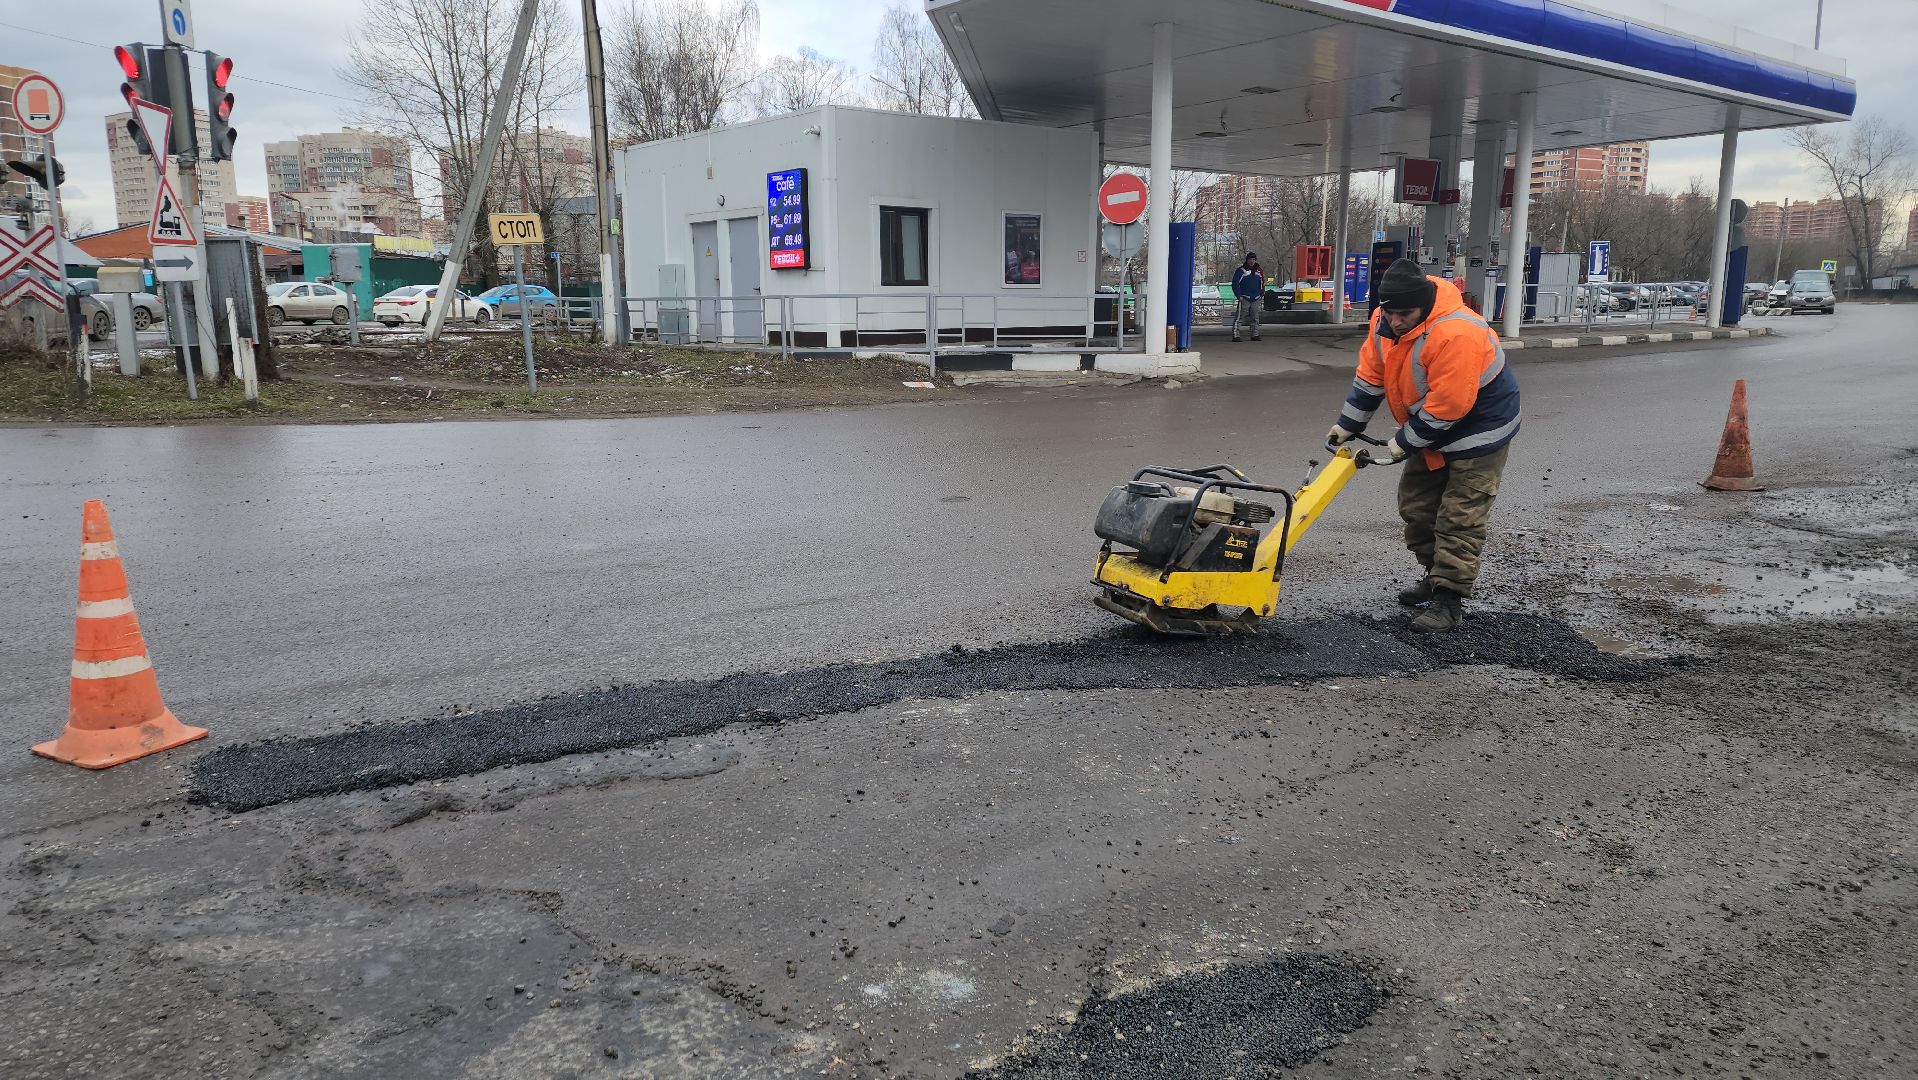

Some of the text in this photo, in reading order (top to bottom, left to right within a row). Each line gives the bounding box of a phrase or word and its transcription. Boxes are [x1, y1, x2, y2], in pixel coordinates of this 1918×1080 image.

[776, 175, 795, 191] café
[783, 194, 801, 206] 54.99
[498, 220, 537, 239] СТОП
[770, 235, 781, 247] ДТ
